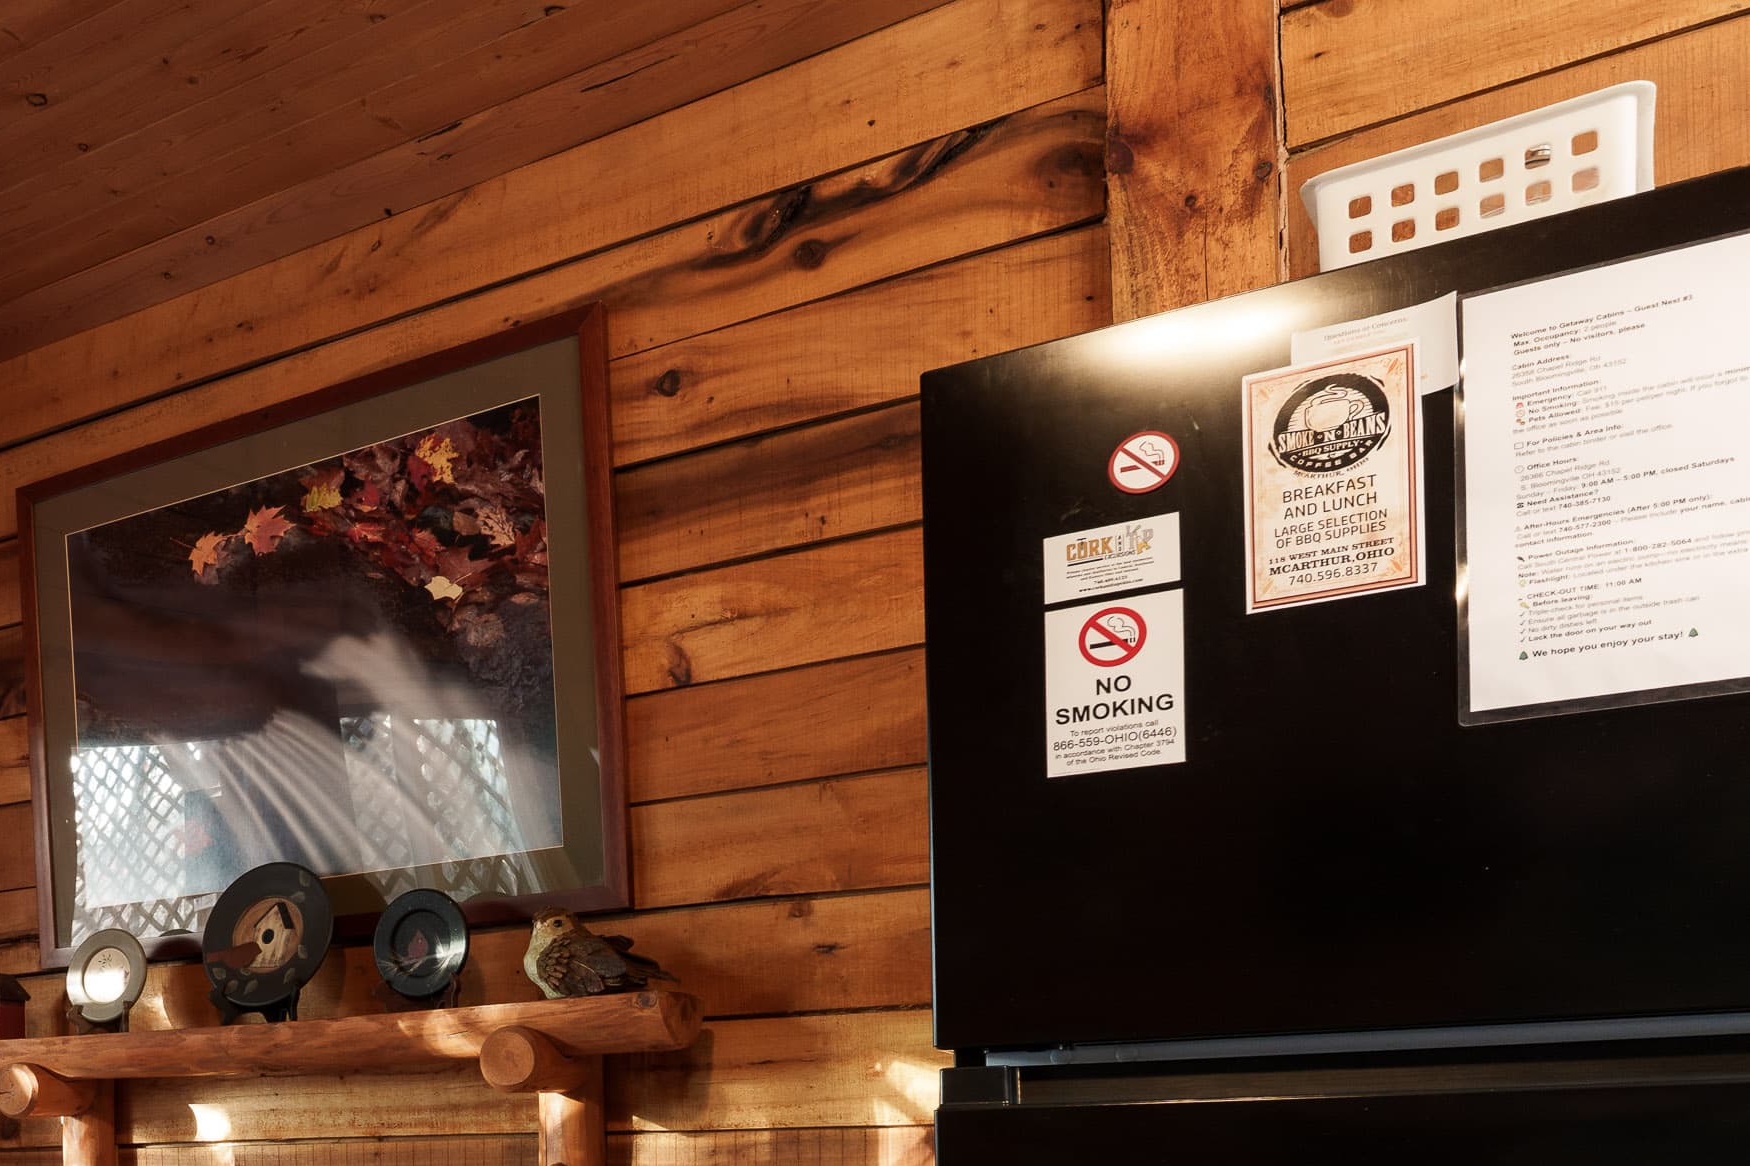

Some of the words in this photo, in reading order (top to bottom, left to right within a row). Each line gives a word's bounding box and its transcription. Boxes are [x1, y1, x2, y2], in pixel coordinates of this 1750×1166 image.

[1511, 328, 1547, 339] Welcome
[1559, 317, 1593, 328] Getaway
[1596, 311, 1624, 320] Cabins
[1634, 302, 1659, 311] Guest
[1661, 297, 1680, 306] Nest
[1514, 345, 1541, 356] Guests
[1618, 323, 1645, 334] please
[1512, 361, 1535, 371] Cabin
[1512, 388, 1550, 401] Important
[1528, 414, 1546, 422] Pets
[1278, 430, 1315, 453] SMOKE
[1343, 412, 1386, 439] BEANS
[1542, 434, 1573, 444] Policies
[1584, 427, 1604, 436] Area
[1289, 455, 1342, 468] COFFEE
[1349, 440, 1373, 459] BAR
[1302, 448, 1322, 456] BBQ
[1323, 440, 1359, 452] SUPPLY
[1527, 462, 1551, 470] Office
[1581, 480, 1599, 488] 9:00
[1661, 465, 1689, 474] closed
[1692, 457, 1735, 467] Saturdays
[1282, 474, 1376, 503] BREAKFAST
[1527, 498, 1547, 506] Need
[1549, 489, 1599, 502] Assistance?
[1284, 503, 1317, 520] AND
[1322, 492, 1377, 512] LUNCH
[1559, 495, 1611, 510] 740-385-7130
[1274, 522, 1314, 538] LARGE
[1318, 509, 1387, 530] SELECTION
[1524, 519, 1570, 530] After-Hours
[1572, 509, 1625, 522] Emergencies
[1628, 505, 1650, 514] (After
[1653, 501, 1670, 509] 5:00
[1559, 519, 1611, 533] 740-577-2300
[1680, 506, 1698, 515] your
[1276, 538, 1291, 548] OF
[1296, 532, 1321, 546] BBQ
[1325, 521, 1386, 540] SUPPLIES
[1515, 540, 1545, 548] contact
[1067, 536, 1113, 561] CORK
[1289, 551, 1318, 561] WEST
[1321, 546, 1348, 555] MAIN
[1352, 537, 1394, 550] STREET
[1528, 552, 1552, 560] Power
[1555, 548, 1584, 556] Outage
[1289, 562, 1378, 585] 740.596.8337
[1527, 587, 1576, 600] CHECK-OUT
[1606, 579, 1626, 587] 11:00
[1533, 599, 1558, 607] Before
[1529, 634, 1548, 642] Lock
[1565, 628, 1584, 637] door
[1599, 625, 1616, 633] your
[1619, 622, 1636, 630] way
[1532, 650, 1548, 658] We
[1551, 646, 1576, 655] hope
[1579, 643, 1598, 653] you
[1600, 639, 1629, 650] enjoy
[1632, 635, 1655, 646] your
[1658, 631, 1683, 641] stay!
[1096, 675, 1131, 695] NO
[1055, 694, 1174, 725] SMOKING
[1053, 727, 1177, 751] 866-559-OHIO(6446)
[1081, 728, 1104, 736] report
[1106, 723, 1143, 733] violations
[1063, 749, 1105, 759] accordance
[1124, 742, 1154, 752] Chapter
[1089, 755, 1106, 763] Ohio
[1108, 751, 1138, 760] Revised
